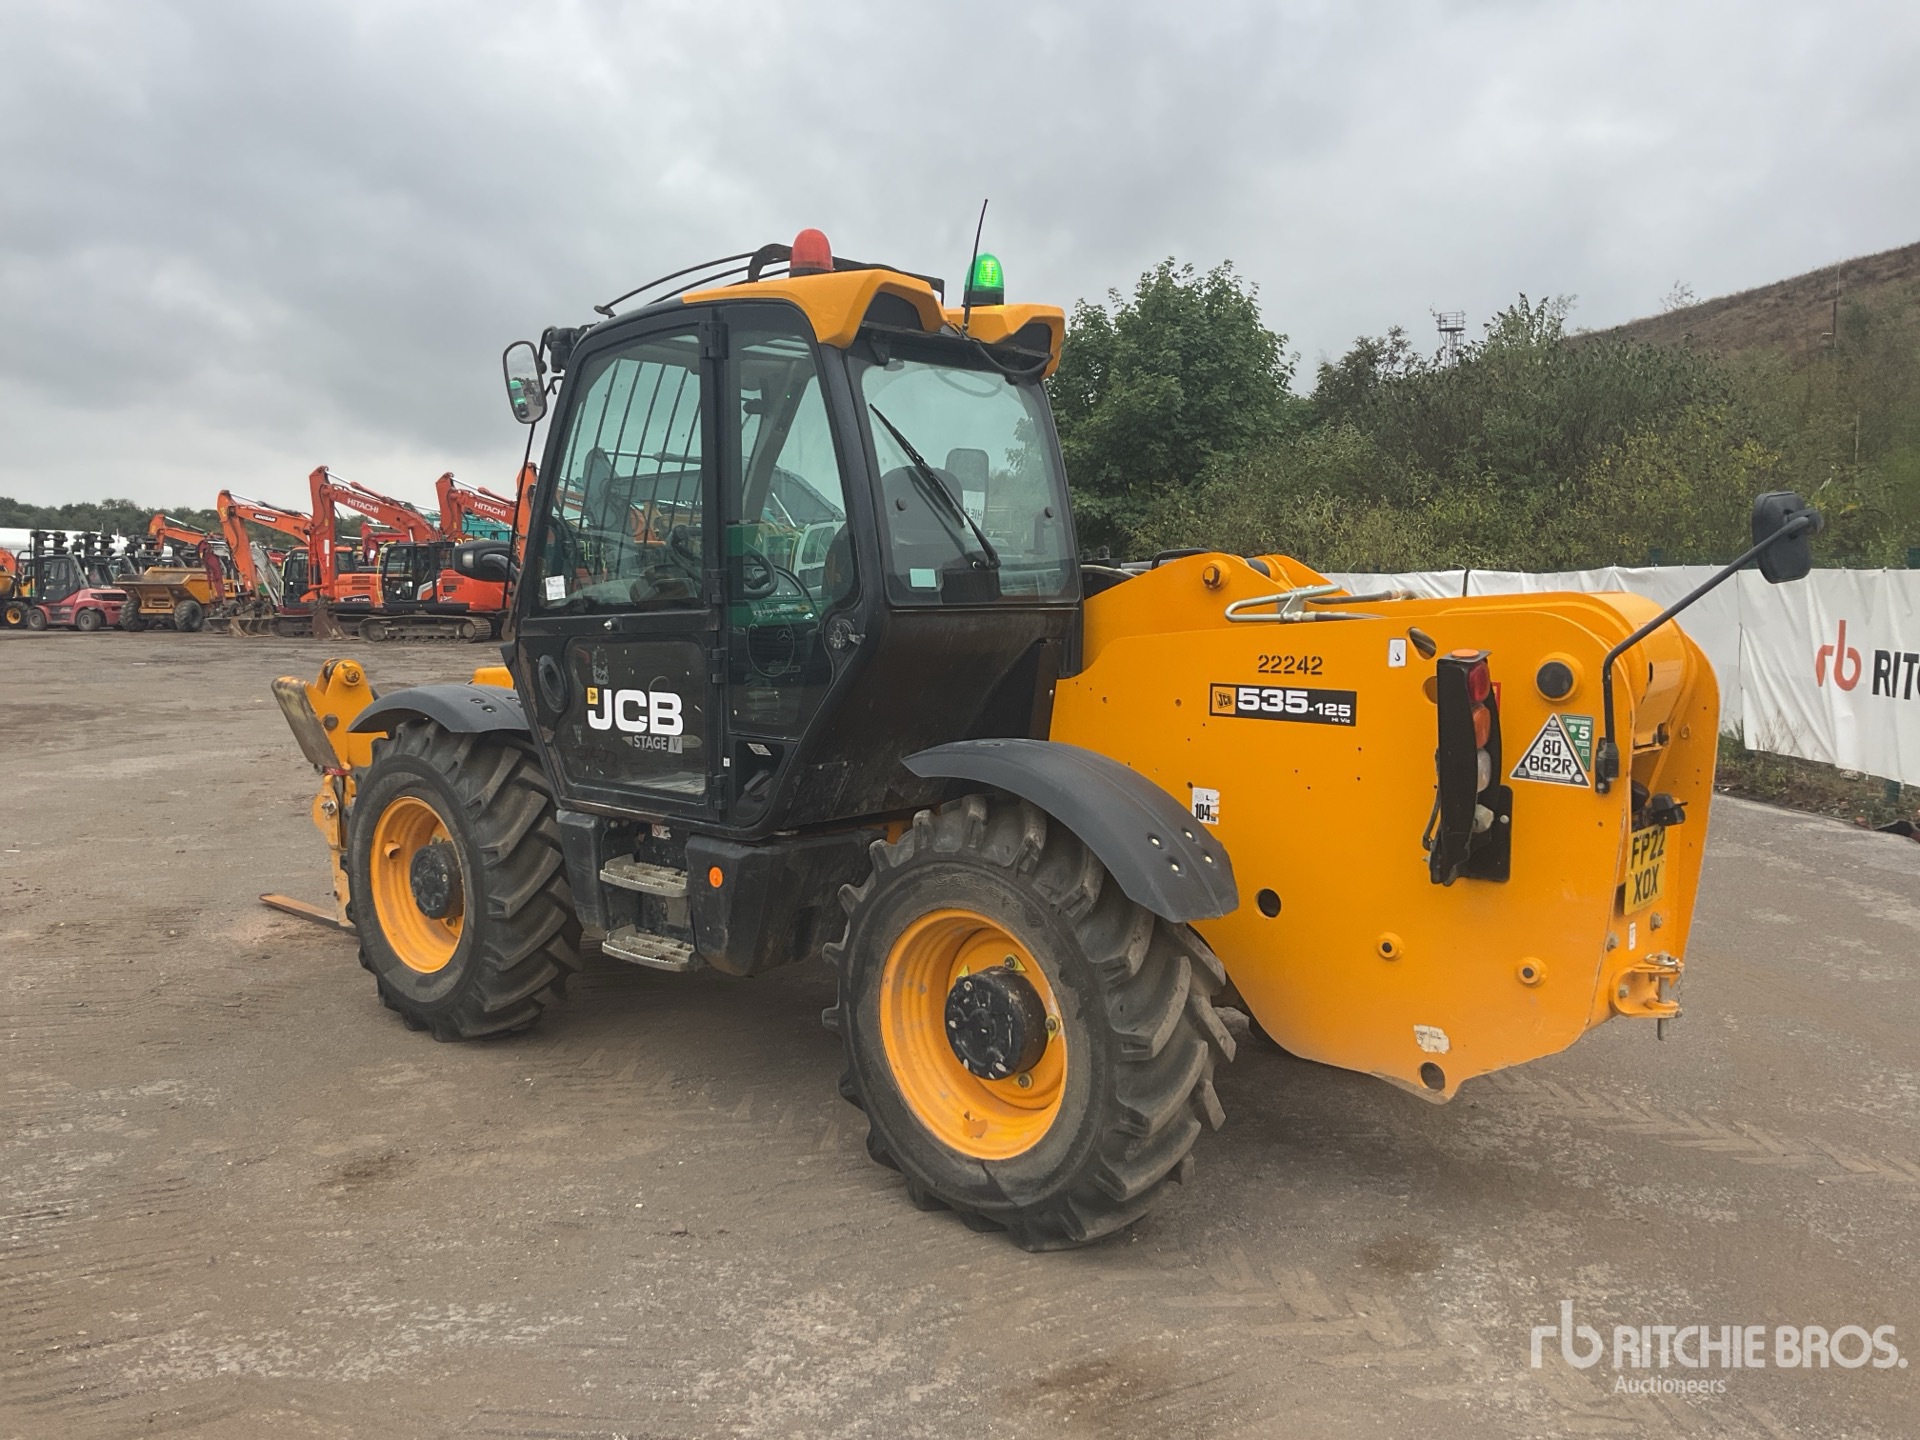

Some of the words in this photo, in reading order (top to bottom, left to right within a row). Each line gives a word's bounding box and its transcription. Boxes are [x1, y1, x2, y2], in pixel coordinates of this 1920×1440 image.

[347, 498, 379, 513] HITACHI
[474, 501, 506, 517] HITACHI
[1257, 655, 1323, 675] 22242
[1872, 649, 1920, 700] RIT
[1237, 687, 1351, 716] 535-125
[587, 688, 684, 736] JCB
[1578, 726, 1590, 739] 5
[633, 735, 667, 751] STAGE
[1529, 755, 1572, 775] BG2R
[1195, 803, 1210, 820] 104
[1631, 825, 1665, 869] FP22
[1633, 864, 1660, 904] XOX
